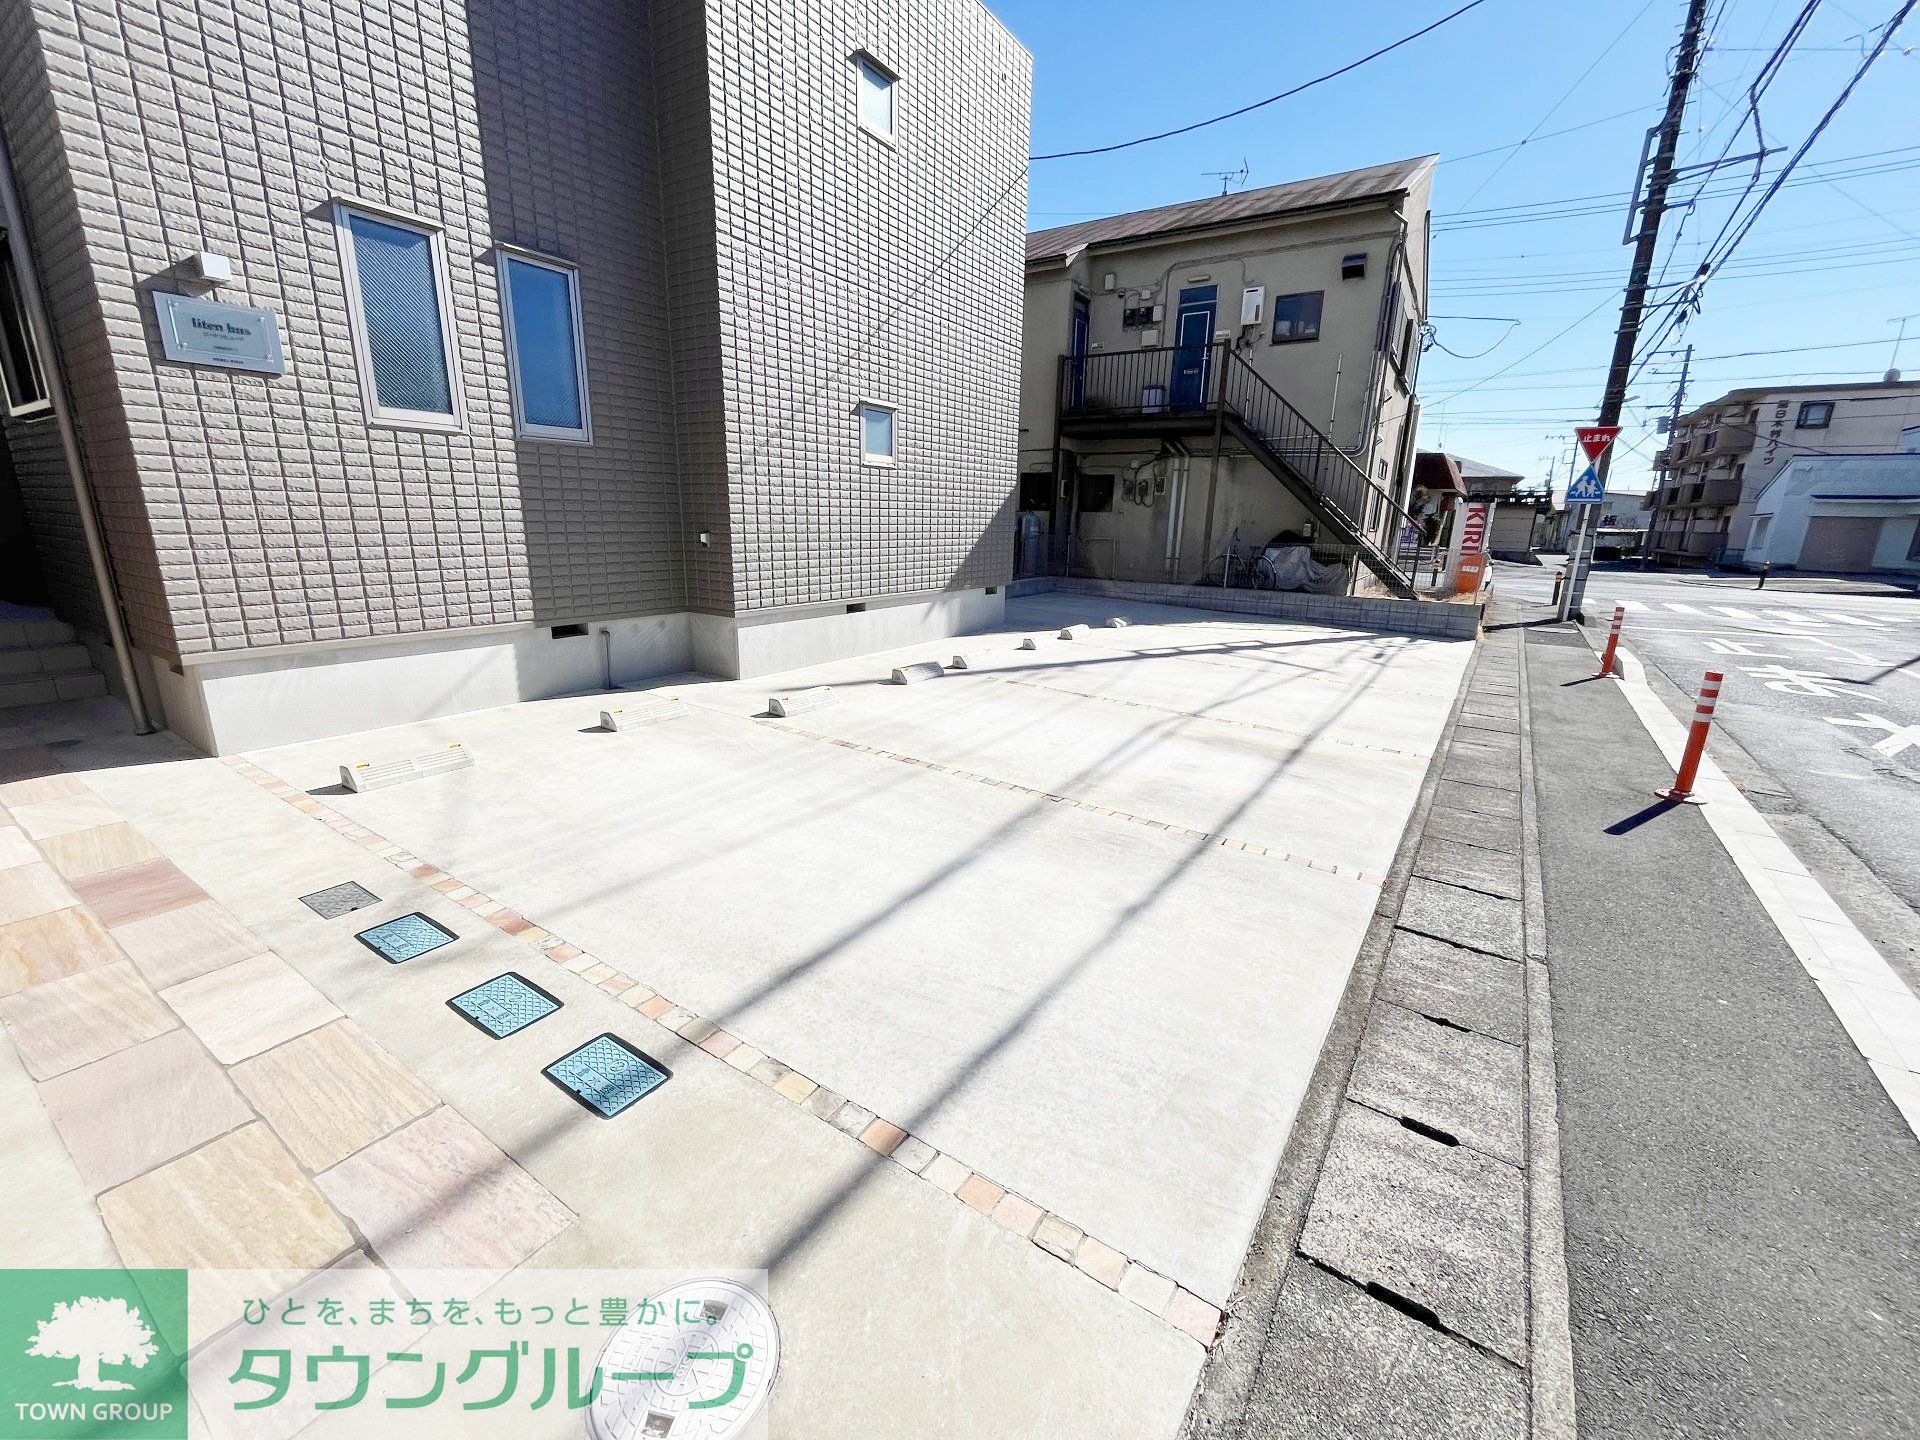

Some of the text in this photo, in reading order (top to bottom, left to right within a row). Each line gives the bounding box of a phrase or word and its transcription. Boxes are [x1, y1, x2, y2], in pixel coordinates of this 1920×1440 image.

[1582, 433, 1611, 442] 止まれ
[1460, 507, 1488, 556] KIRI
